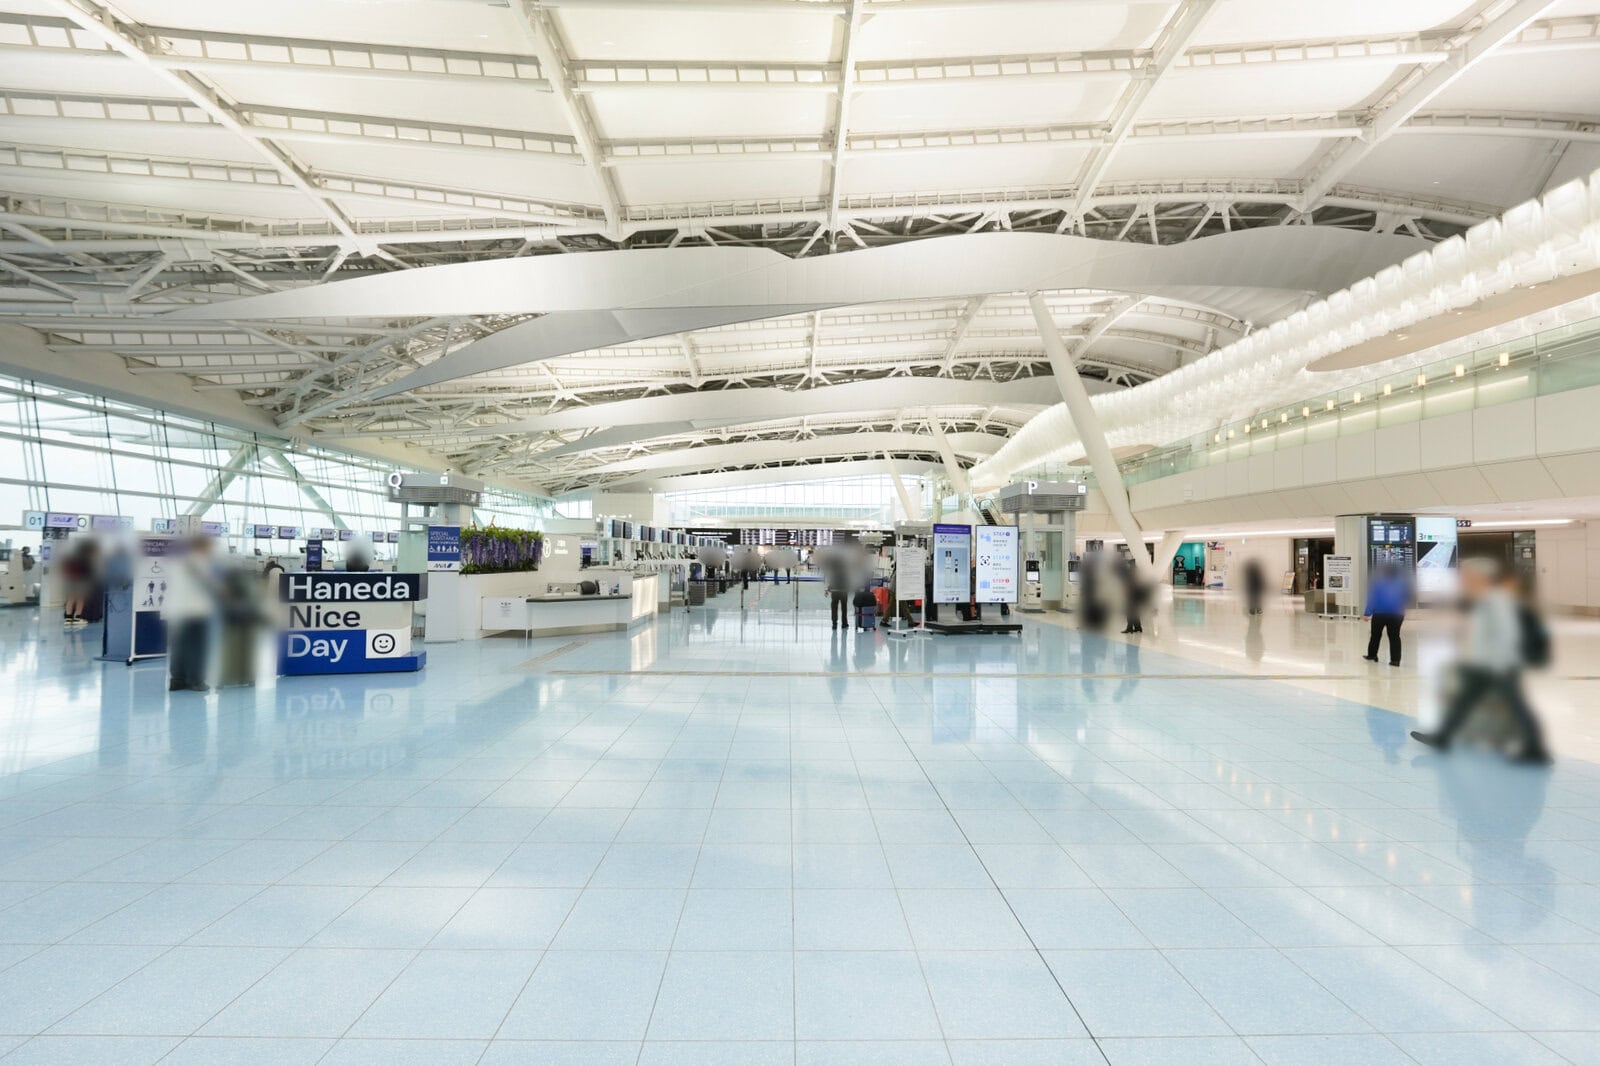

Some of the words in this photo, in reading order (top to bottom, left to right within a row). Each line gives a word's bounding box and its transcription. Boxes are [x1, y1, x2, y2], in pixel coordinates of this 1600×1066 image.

[388, 472, 402, 490] Q
[1028, 480, 1038, 495] P
[29, 516, 42, 526] 01
[289, 576, 410, 600] Haneda
[289, 605, 361, 629] Nice
[287, 633, 349, 663] Day
